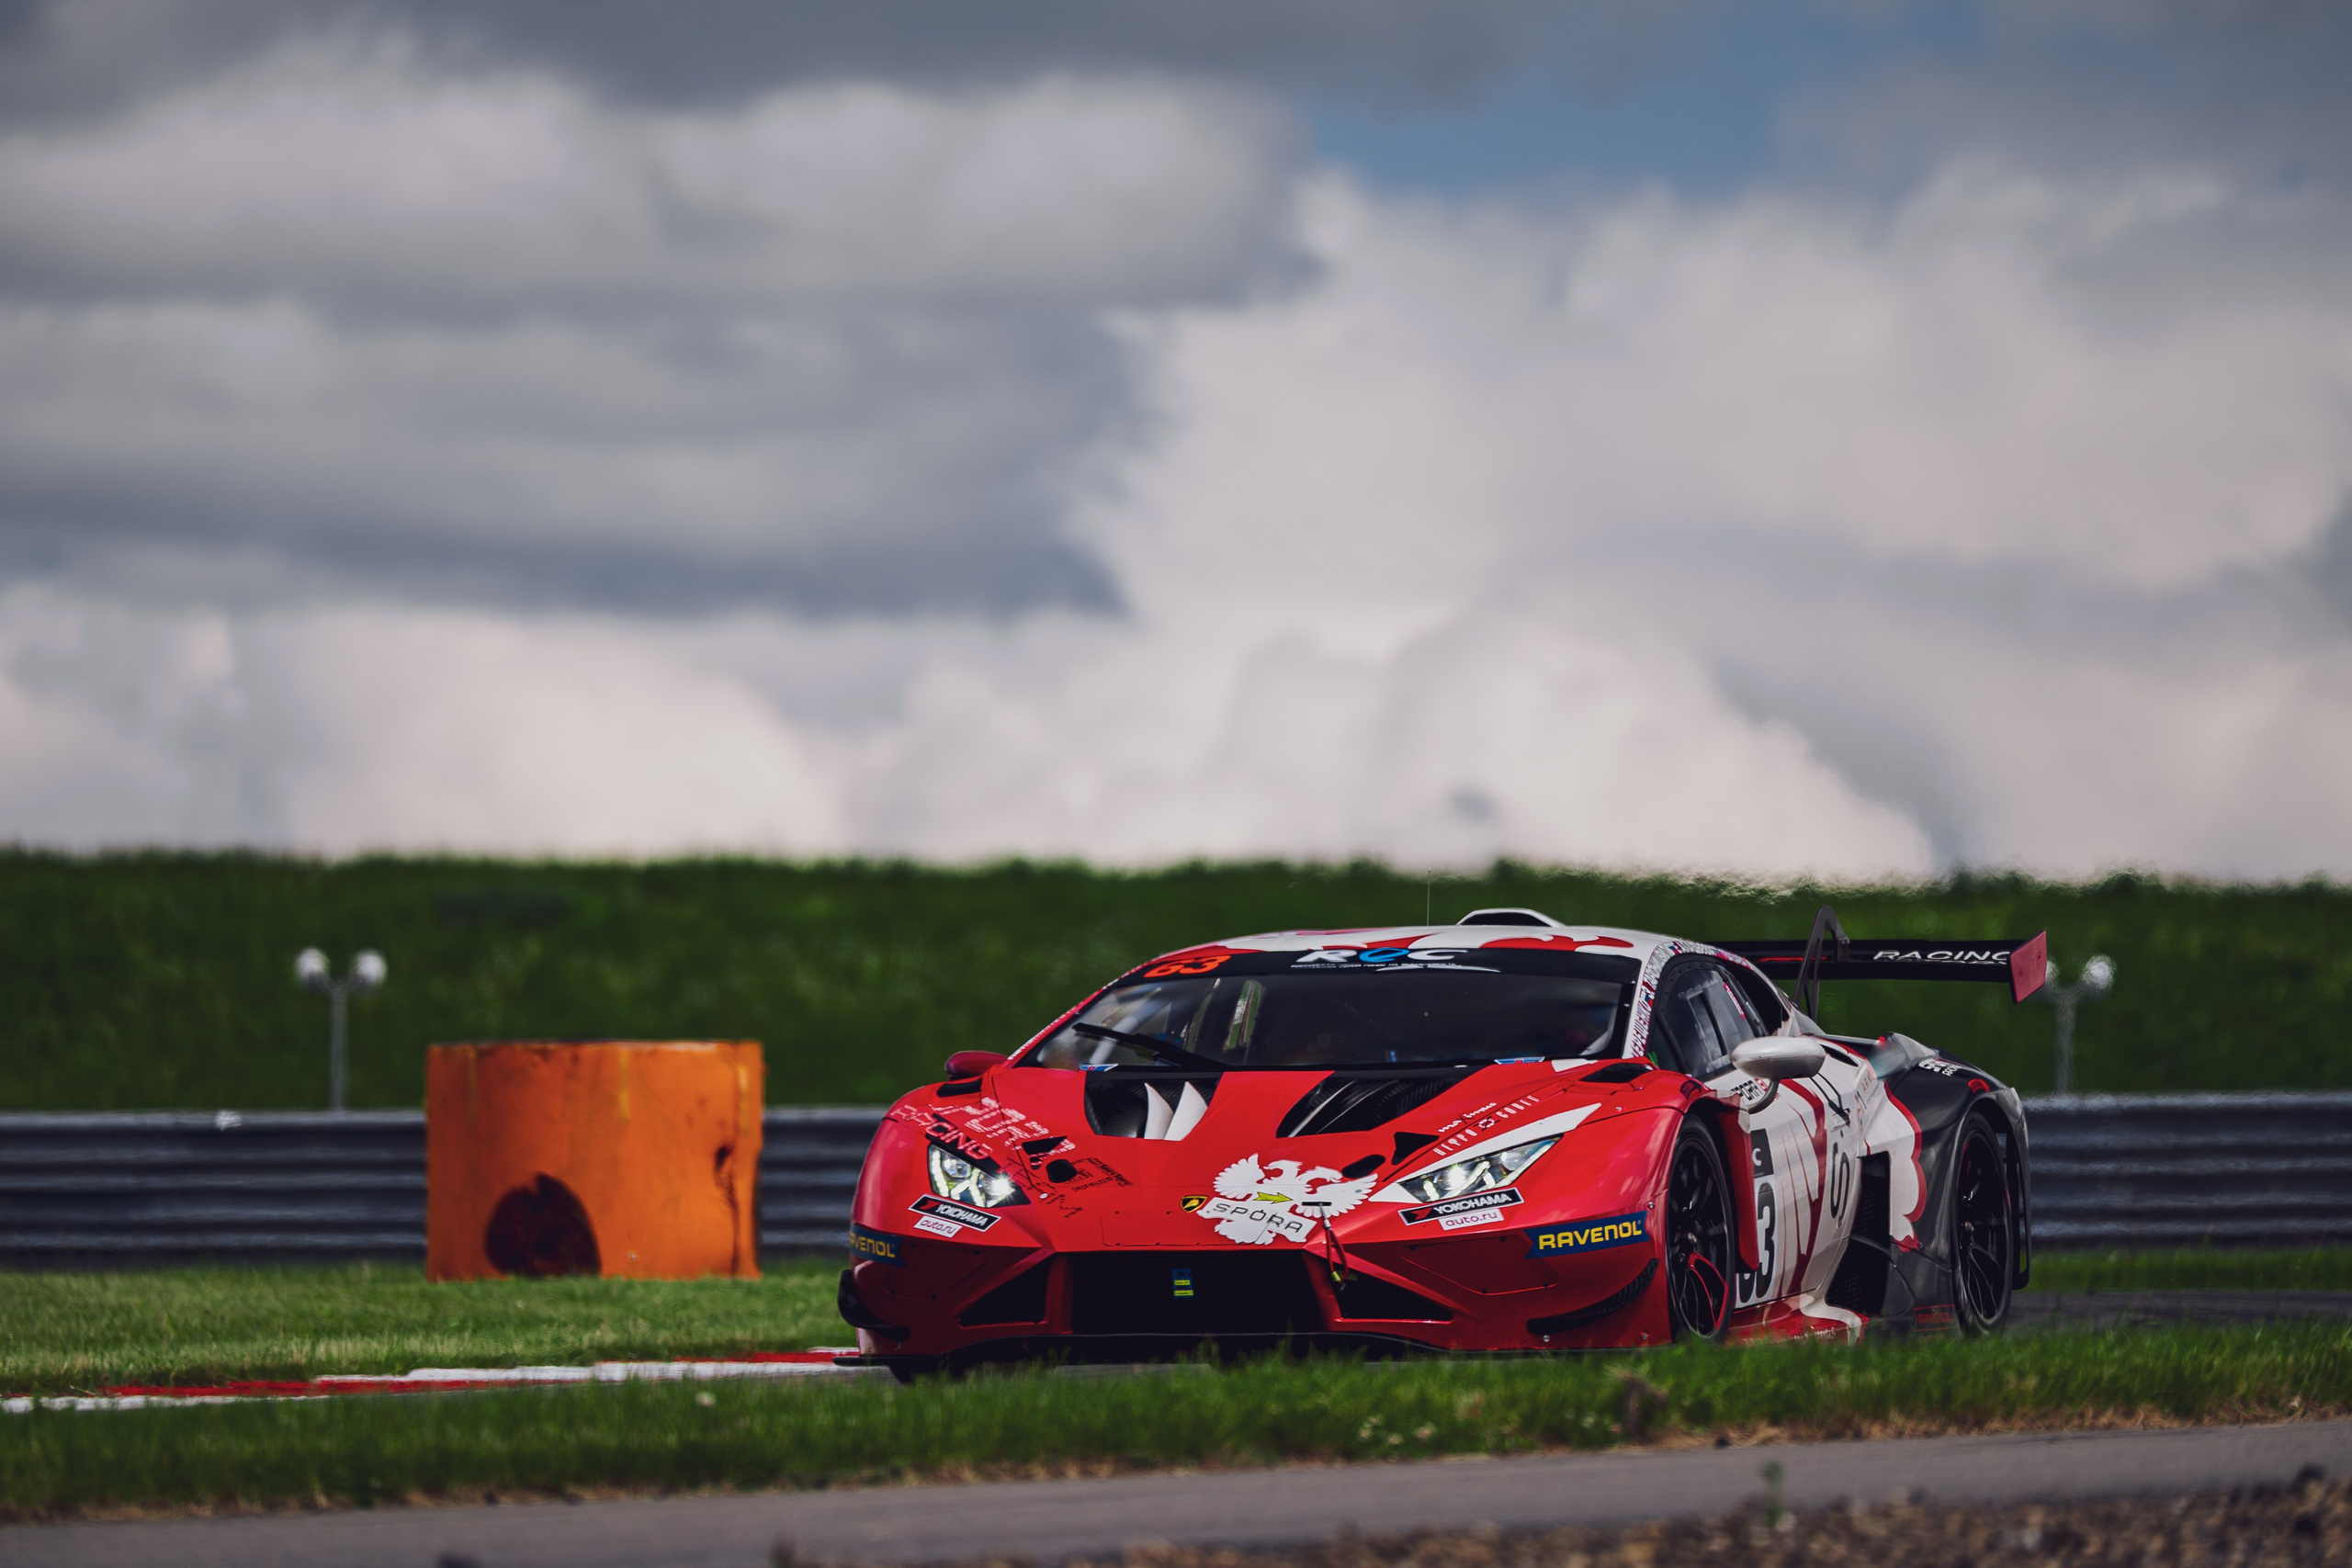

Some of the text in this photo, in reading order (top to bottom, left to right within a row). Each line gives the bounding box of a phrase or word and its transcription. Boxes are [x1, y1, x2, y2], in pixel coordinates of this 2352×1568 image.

[1144, 954, 1232, 978] 63
[935, 1203, 989, 1226] YOKOHAMA
[1432, 1193, 1512, 1214] YOKOHAMA
[920, 1218, 956, 1235] auto.ru
[1444, 1211, 1498, 1227] auto.ru
[850, 1232, 896, 1258] VENOL
[1538, 1221, 1643, 1250] RAVENOL
